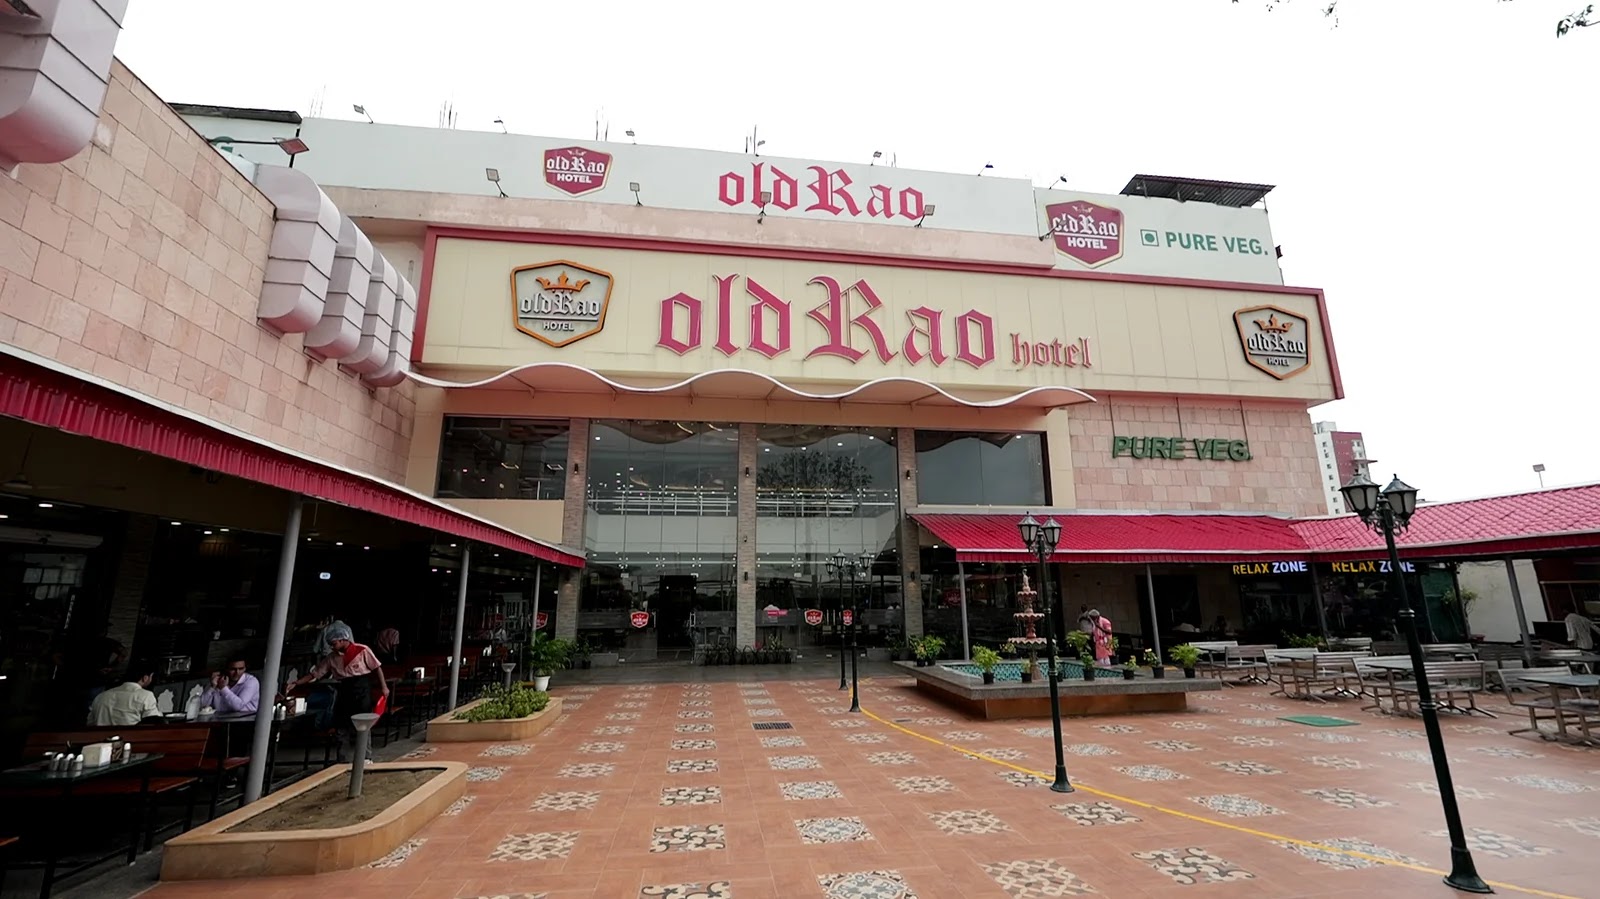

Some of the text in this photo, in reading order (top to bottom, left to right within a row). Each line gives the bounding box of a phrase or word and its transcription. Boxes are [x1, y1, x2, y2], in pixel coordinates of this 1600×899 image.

[557, 173, 592, 184] HOTEL
[1067, 237, 1108, 250] HOTEL
[1165, 231, 1268, 256] PURE VEG.
[543, 321, 575, 332] HOTEL
[1010, 332, 1092, 371] hotel
[1267, 357, 1290, 367] HOTEL
[1112, 436, 1186, 460] PURE
[1232, 561, 1308, 575] RELAX ZONE
[1331, 561, 1376, 573] RELAX
